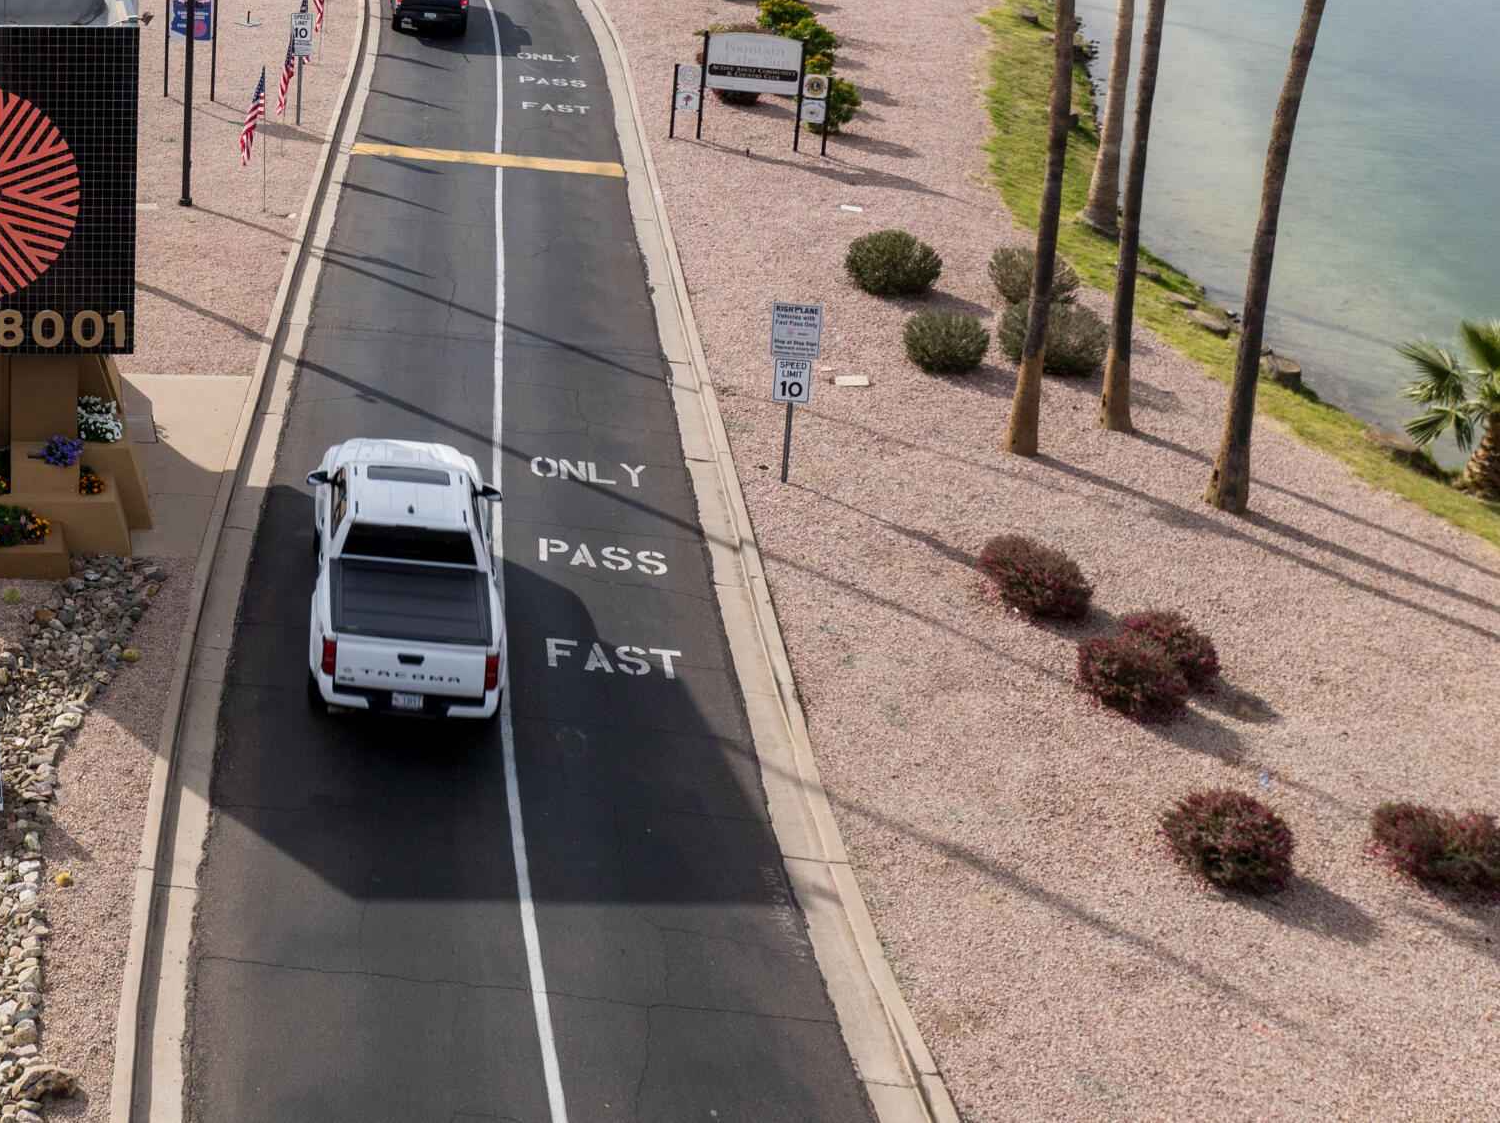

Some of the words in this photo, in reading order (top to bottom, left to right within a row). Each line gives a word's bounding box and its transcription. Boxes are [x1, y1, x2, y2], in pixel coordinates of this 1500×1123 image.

[294, 27, 308, 39] 10
[725, 40, 786, 56] Fountain
[516, 52, 580, 63] ONLY
[717, 54, 729, 65] of
[738, 54, 759, 65] the
[764, 56, 790, 68] Sun
[758, 67, 797, 77] COMMUNITY
[519, 75, 588, 88] PASS
[522, 101, 591, 115] FAST
[800, 307, 819, 315] LANE
[804, 321, 819, 329] Only
[780, 360, 808, 370] SPEED
[782, 369, 803, 378] LIMIT
[780, 380, 803, 398] 10
[530, 456, 646, 487] ONLY
[538, 538, 668, 575] PASS
[545, 637, 682, 679] FAST
[360, 667, 461, 685] TACOMA
